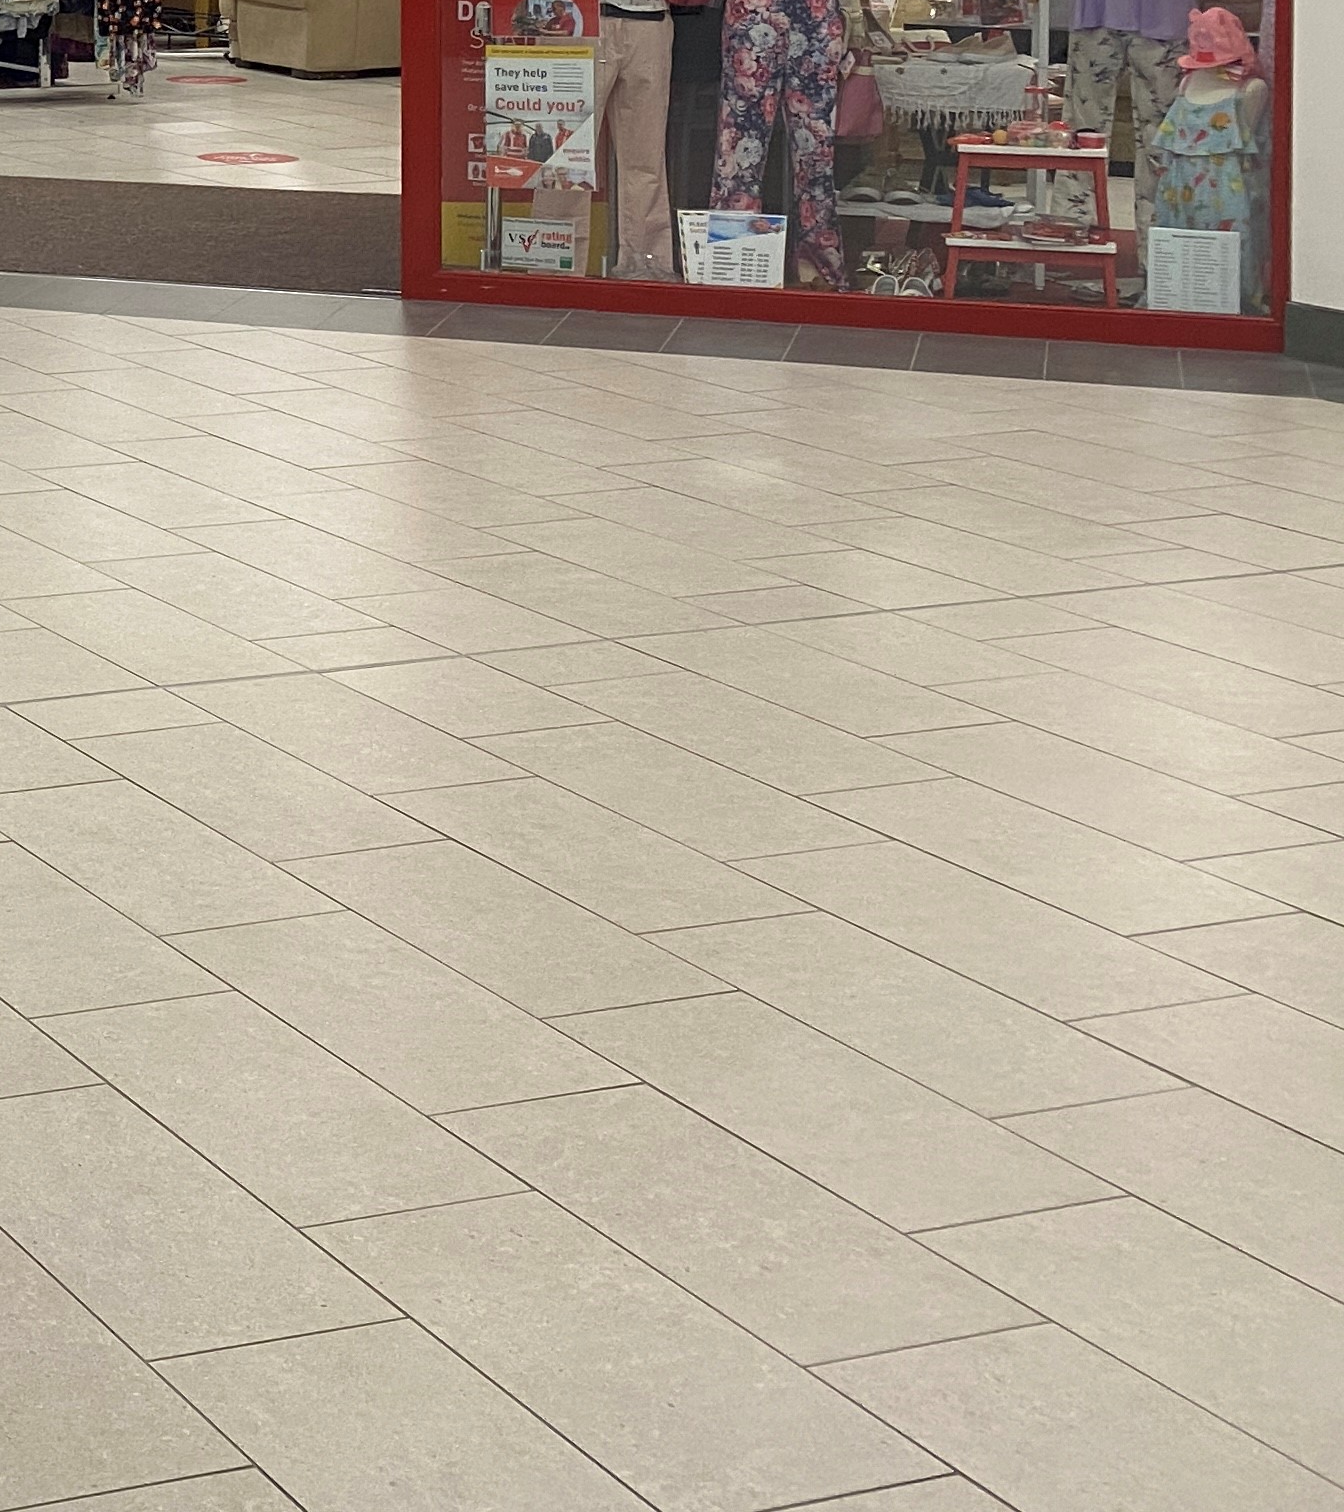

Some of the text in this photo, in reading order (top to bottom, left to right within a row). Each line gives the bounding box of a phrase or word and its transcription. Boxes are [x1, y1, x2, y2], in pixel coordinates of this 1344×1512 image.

[494, 67, 521, 80] They
[523, 67, 548, 79] help
[494, 82, 549, 93] save lives
[495, 97, 586, 115] Could you?
